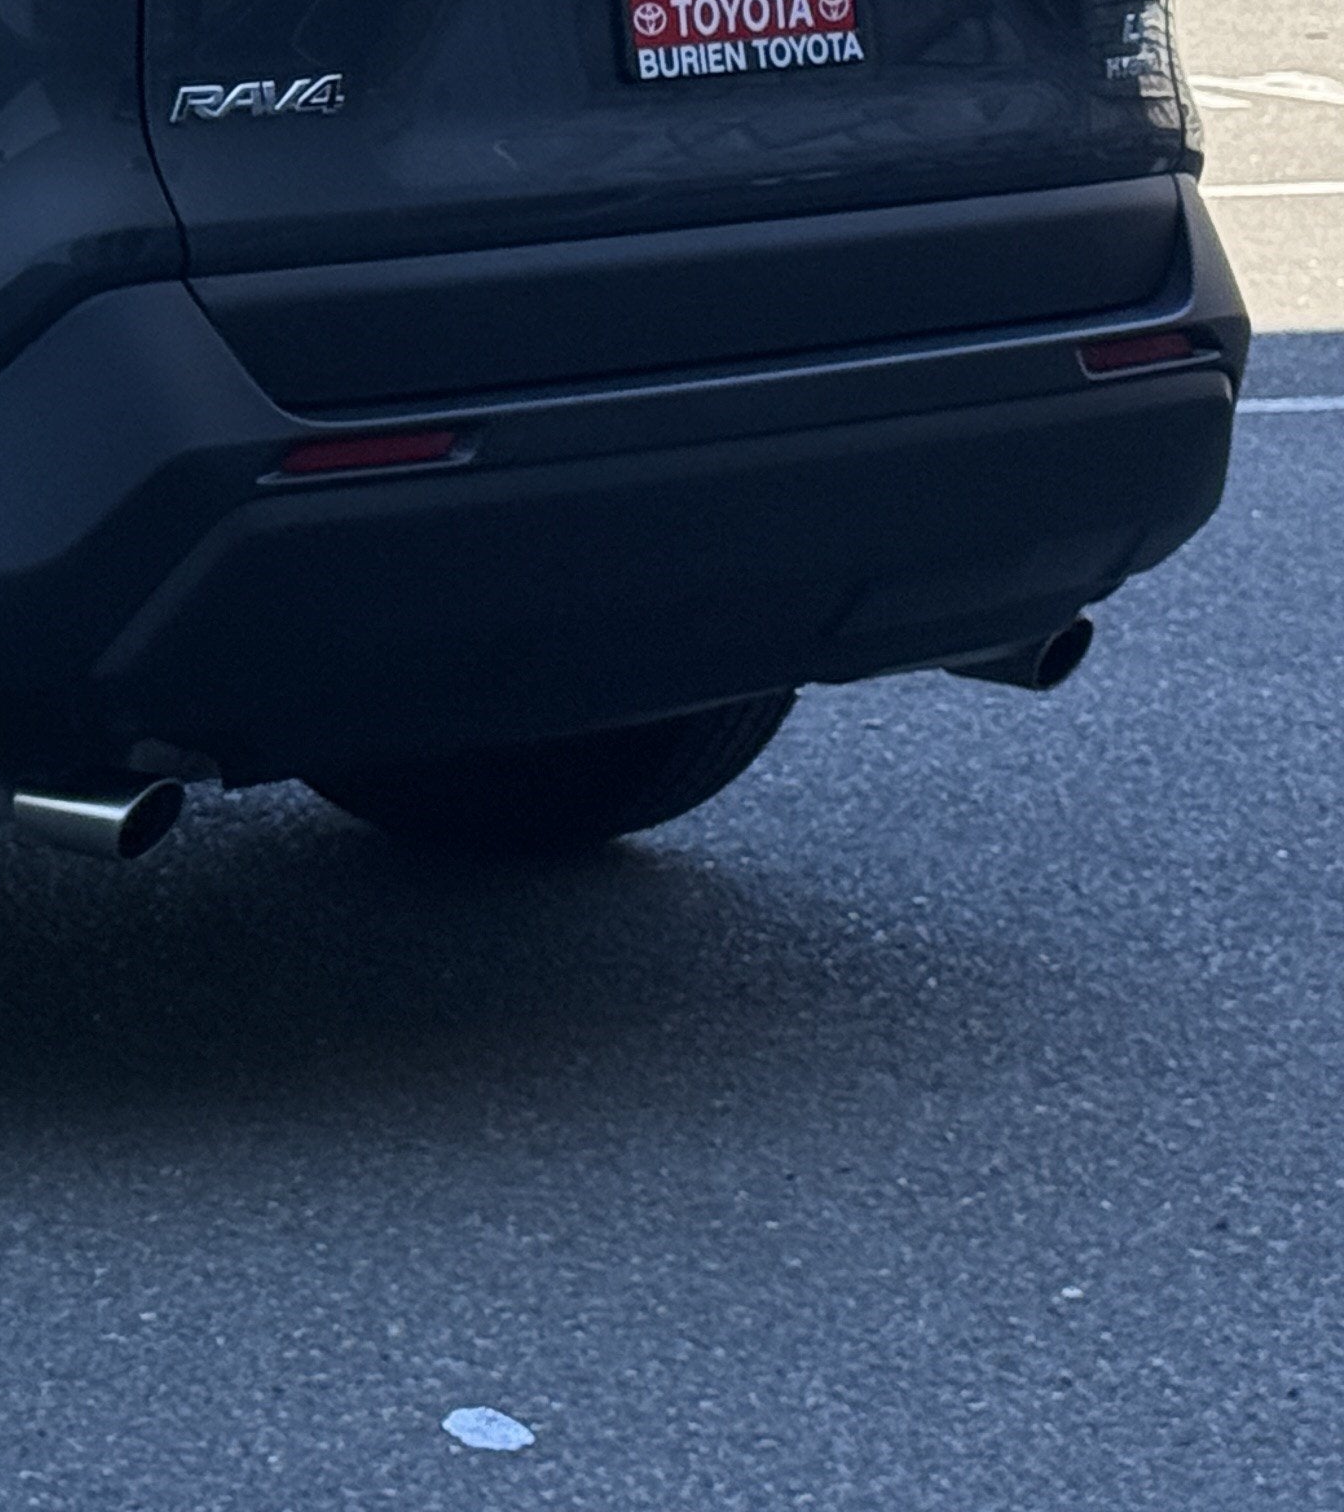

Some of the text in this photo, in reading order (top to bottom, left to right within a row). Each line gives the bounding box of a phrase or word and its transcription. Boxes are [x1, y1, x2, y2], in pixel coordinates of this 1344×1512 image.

[638, 31, 864, 79] BURIEN TOYOTA
[169, 73, 345, 124] RAV4
